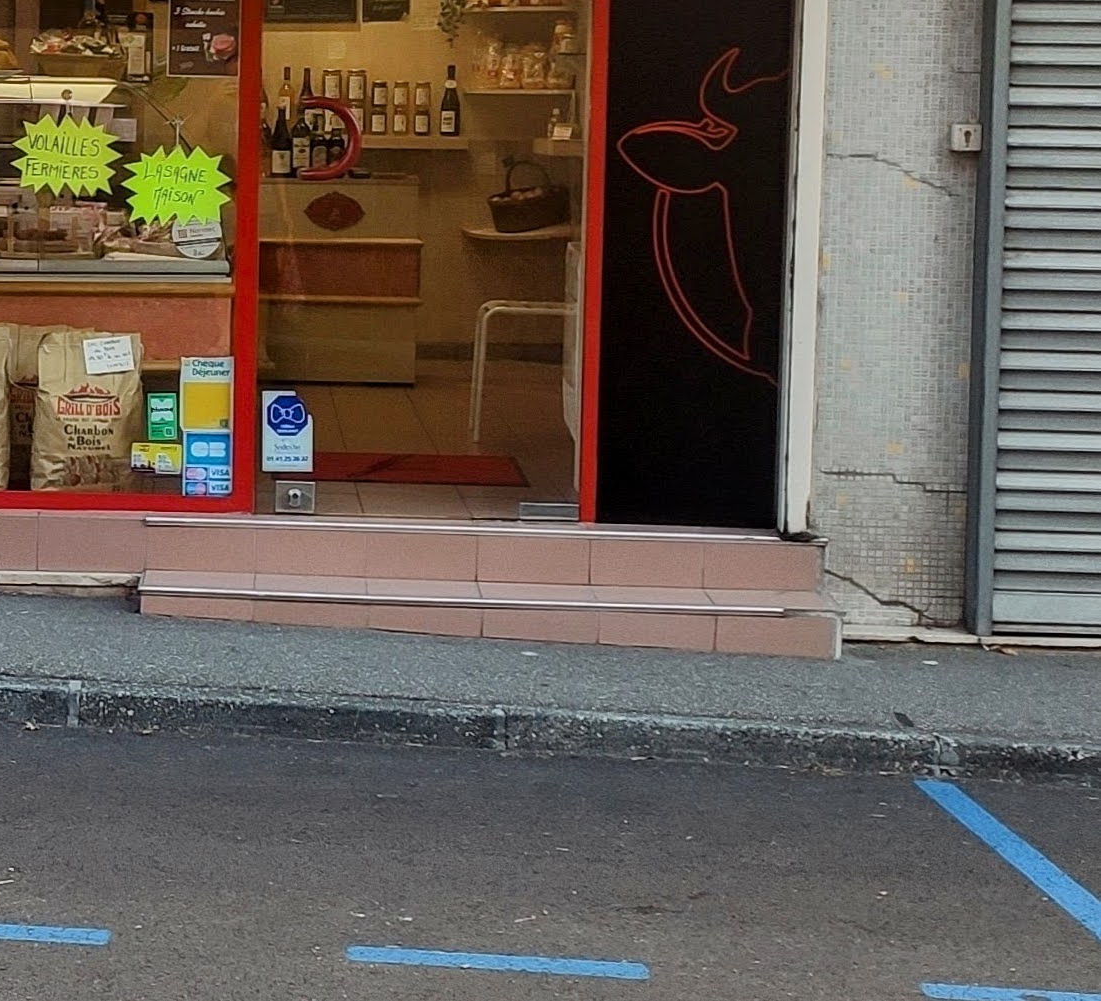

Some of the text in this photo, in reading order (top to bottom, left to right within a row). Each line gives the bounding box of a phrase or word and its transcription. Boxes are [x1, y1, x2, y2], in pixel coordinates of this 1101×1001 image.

[28, 131, 100, 157] VOLAILLES
[142, 161, 208, 184] LASAGNE
[153, 186, 205, 210] MAISON
[192, 368, 230, 377] Déjeuner
[77, 435, 102, 446] Bois
[211, 468, 230, 477] VISA
[211, 483, 230, 492] VISA
